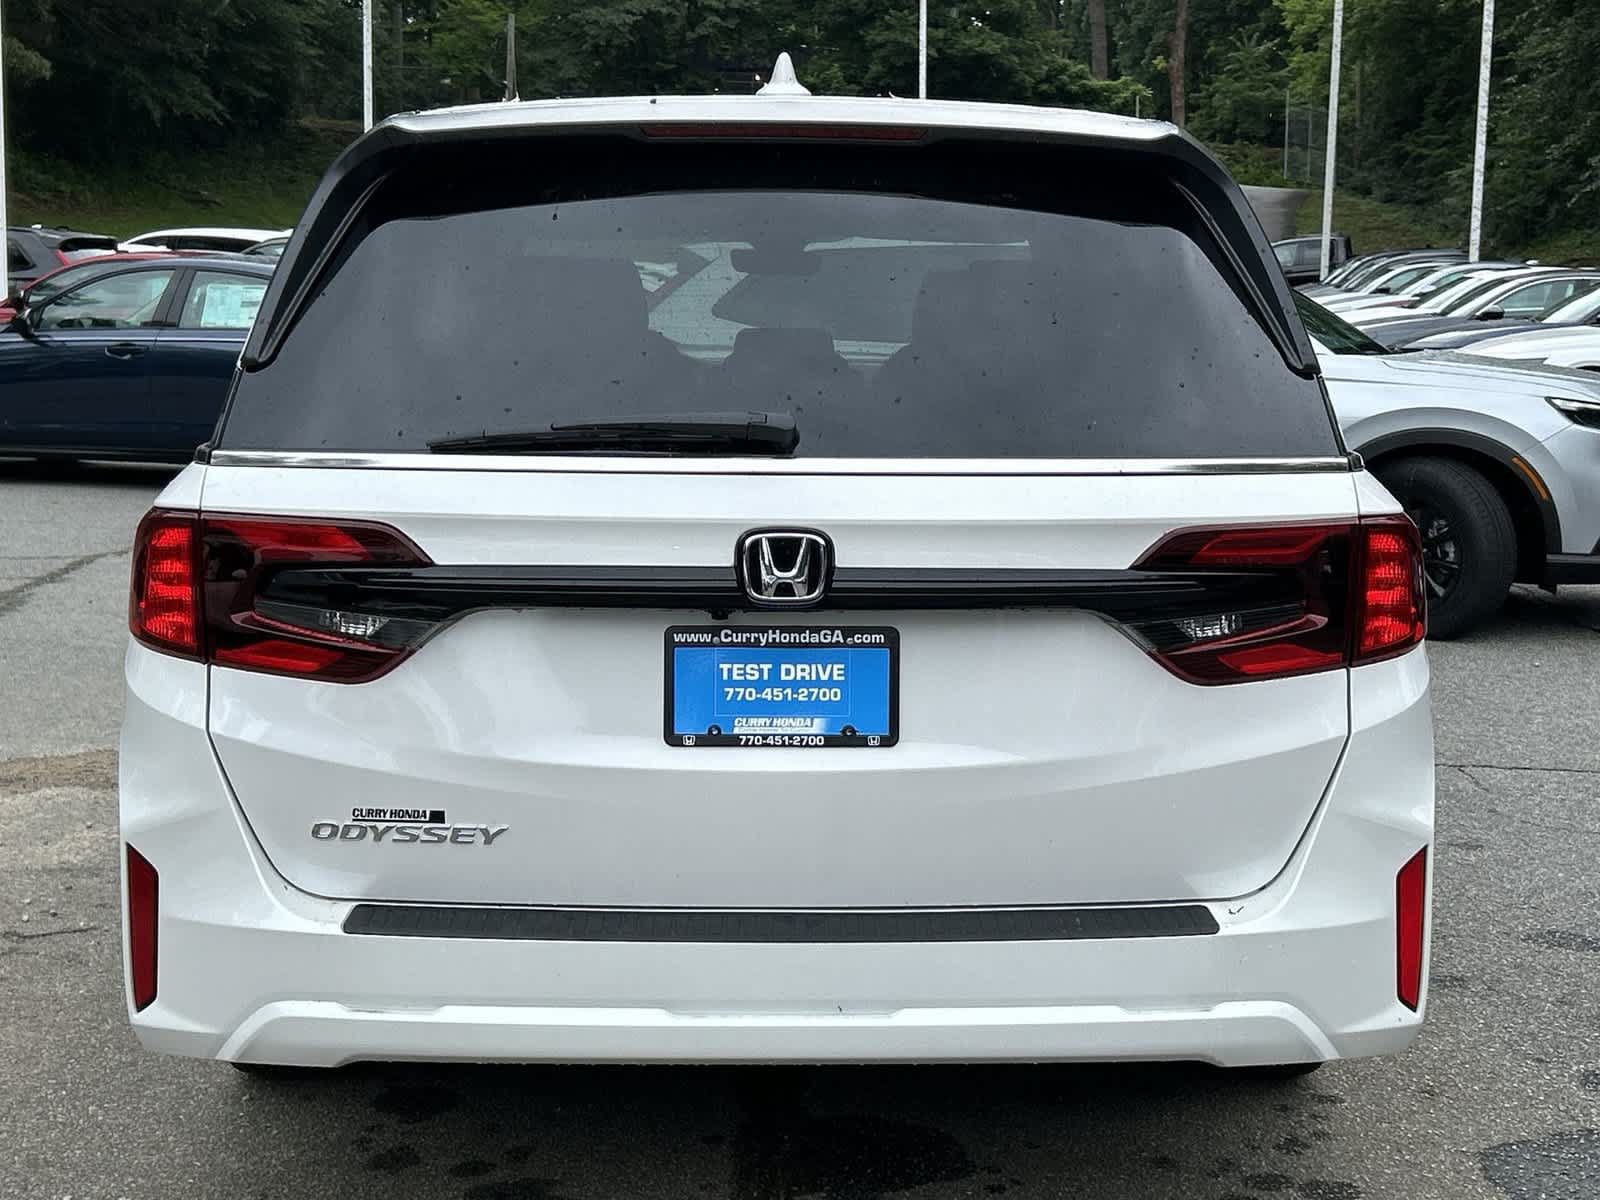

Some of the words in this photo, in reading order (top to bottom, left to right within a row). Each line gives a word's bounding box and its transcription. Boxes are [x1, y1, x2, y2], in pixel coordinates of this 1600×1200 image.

[719, 663, 772, 681] TEST
[780, 663, 845, 681] DRIVE
[724, 687, 841, 702] 770-451-2700
[734, 717, 772, 727] CURRY
[772, 717, 812, 728] HONDA
[739, 735, 825, 746] 770-451-2700
[352, 807, 388, 819] CURRY
[389, 808, 428, 820] HONDA
[311, 822, 510, 845] ODYSSEY
